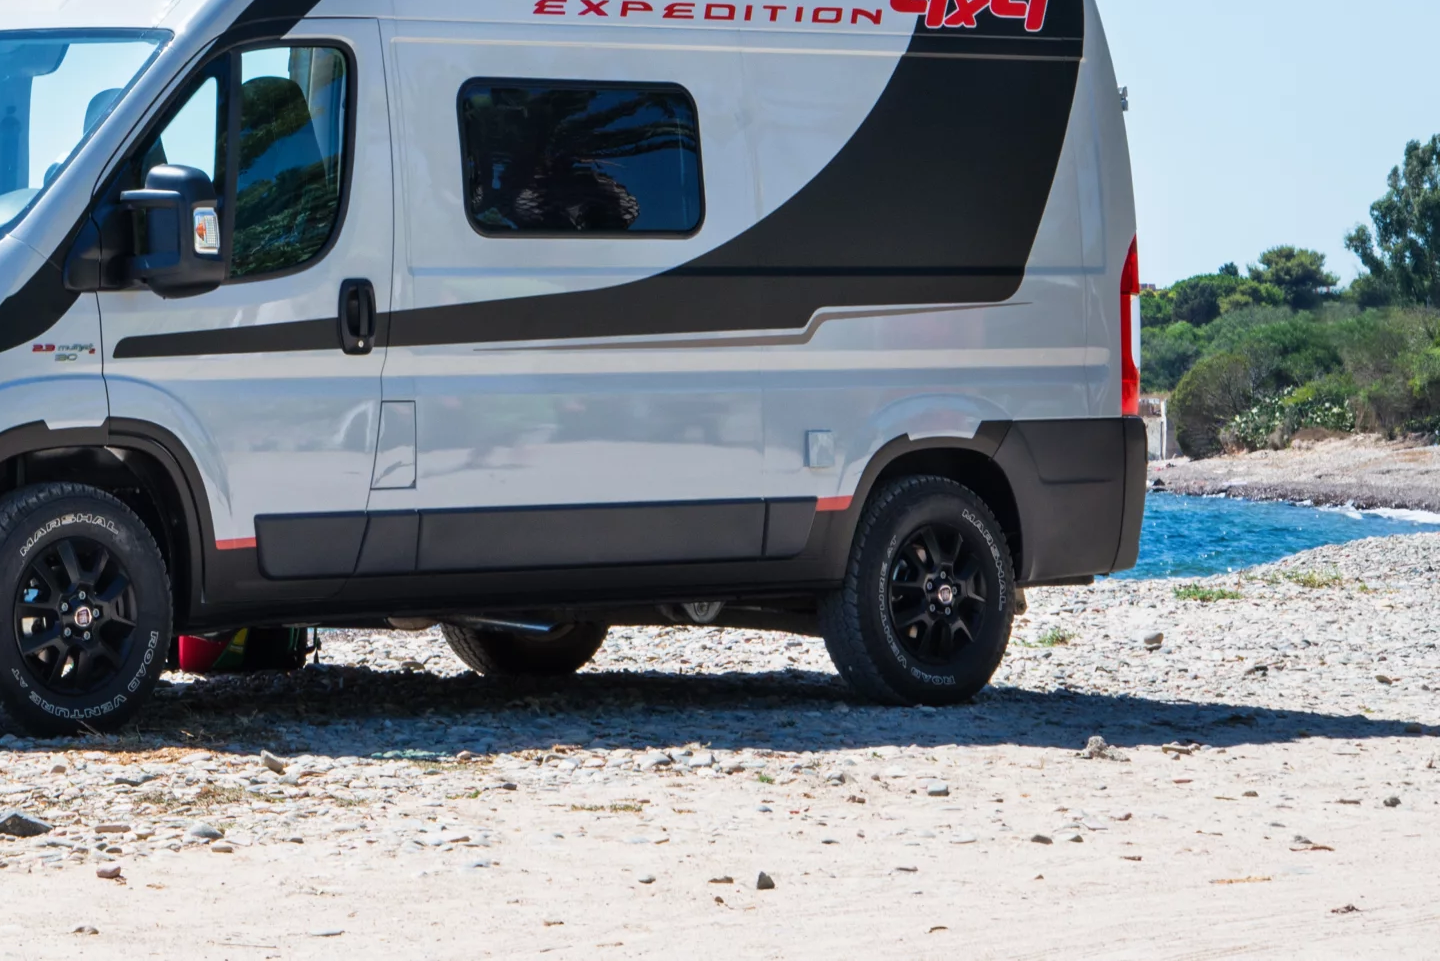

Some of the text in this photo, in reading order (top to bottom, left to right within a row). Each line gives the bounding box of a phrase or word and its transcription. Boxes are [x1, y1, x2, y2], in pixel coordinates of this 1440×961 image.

[19, 513, 119, 557] MARSHAL
[961, 508, 1007, 612] MARSHAL
[11, 630, 159, 719] ROAD VENTURE AT
[910, 666, 956, 686] ROAD
